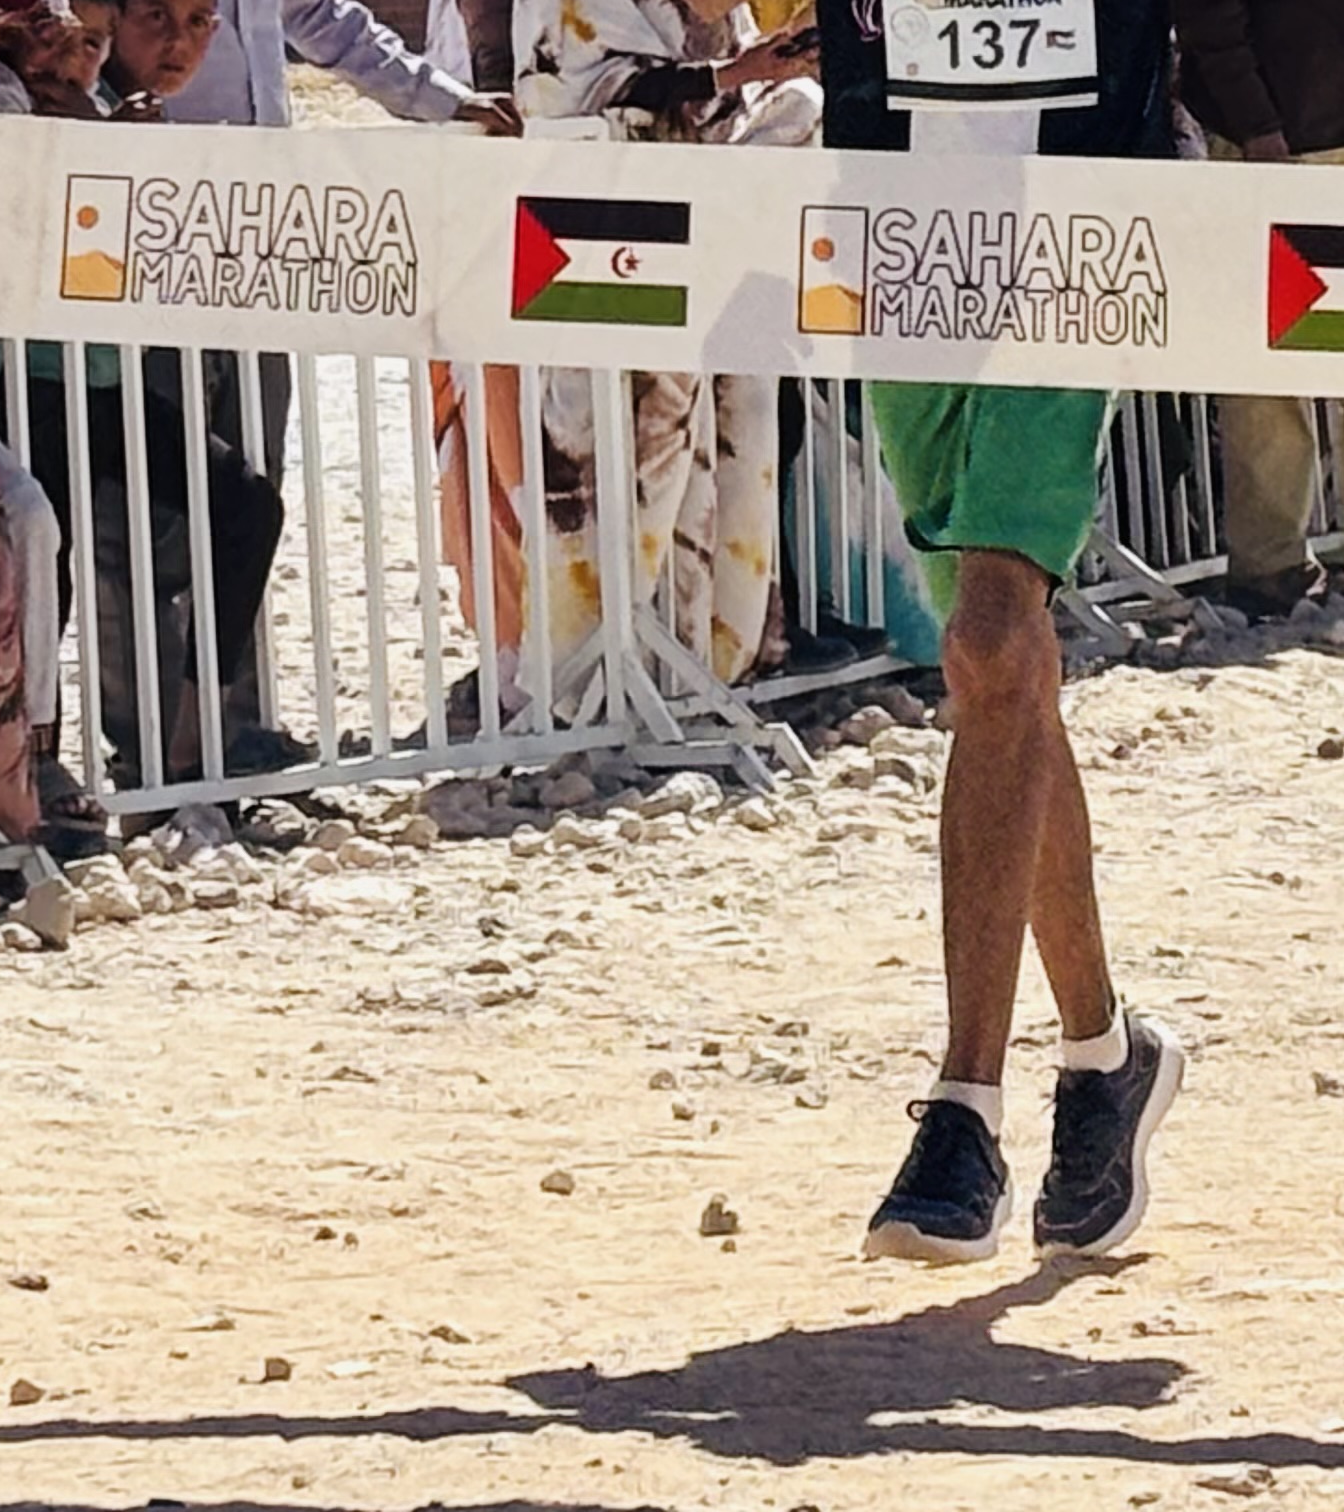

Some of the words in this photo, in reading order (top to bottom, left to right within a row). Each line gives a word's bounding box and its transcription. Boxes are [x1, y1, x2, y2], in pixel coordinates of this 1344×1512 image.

[937, 18, 1041, 70] 137
[134, 177, 418, 265] SAHARA
[872, 207, 1167, 295] SAHARA
[130, 250, 418, 317] MARATHON
[870, 283, 1169, 349] MARATHON
